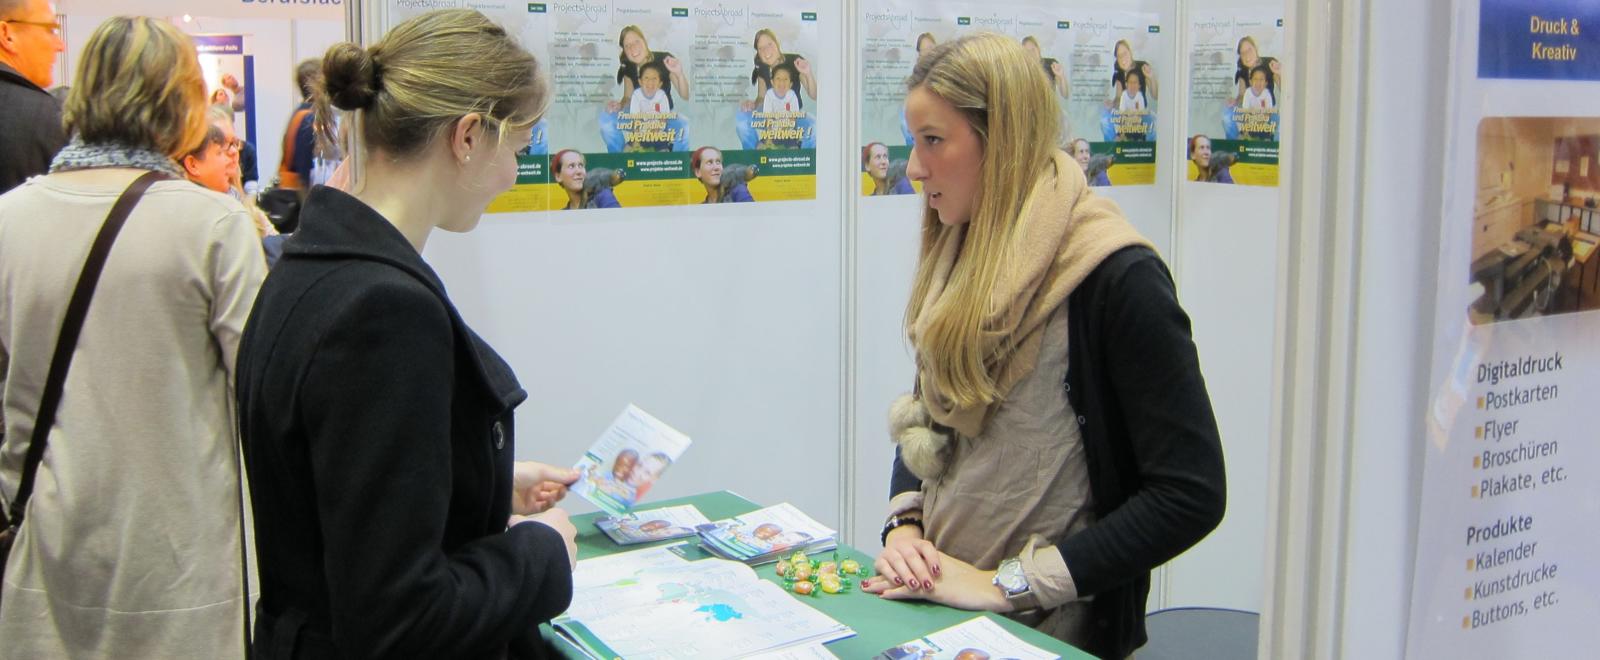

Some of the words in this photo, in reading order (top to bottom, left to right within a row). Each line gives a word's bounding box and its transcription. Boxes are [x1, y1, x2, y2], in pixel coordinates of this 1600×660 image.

[1529, 16, 1568, 35] Druck
[1570, 18, 1580, 35] &
[1531, 42, 1577, 61] Kreativ
[1477, 351, 1563, 385] Digitaldruck
[1485, 382, 1558, 411] Postkarten
[1483, 418, 1519, 442] Flyer
[1481, 439, 1558, 471] Broschüren
[1480, 472, 1536, 499] Plakate,
[1541, 466, 1568, 485] etc.
[1466, 513, 1533, 546] Produkte
[1475, 540, 1537, 572] Kalender
[1473, 562, 1558, 600] Kunstdrucke
[1471, 602, 1528, 630] Buttons,
[1533, 589, 1559, 611] etc.
